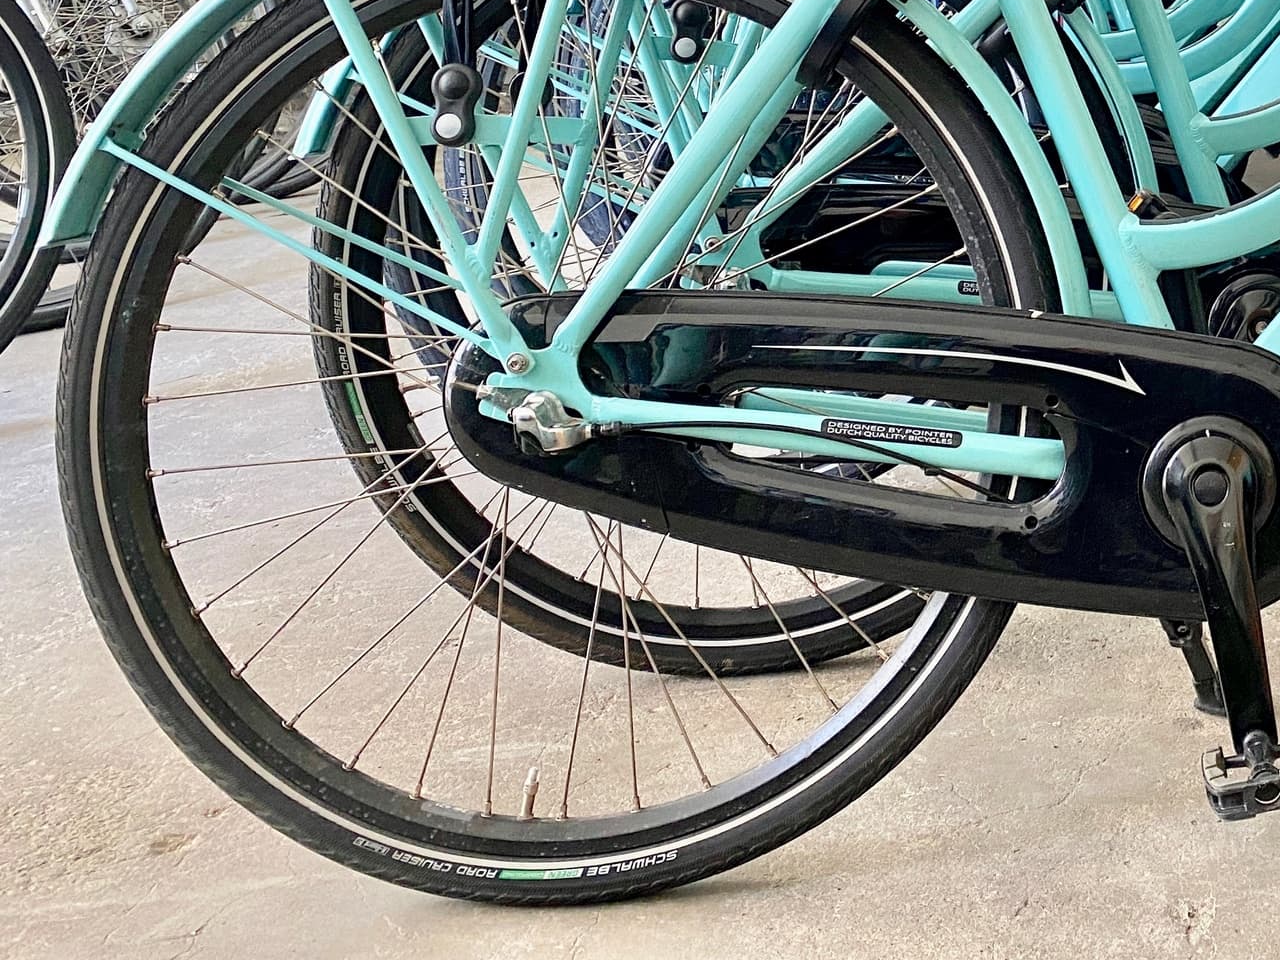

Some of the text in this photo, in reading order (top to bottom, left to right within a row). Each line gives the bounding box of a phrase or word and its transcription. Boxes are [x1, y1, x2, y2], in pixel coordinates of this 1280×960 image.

[333, 291, 344, 338] RUISER
[827, 427, 953, 445] DUTCH QUALITY BICYCLES
[828, 421, 953, 439] DESIGNED BY POINTER
[391, 850, 452, 872] CRUISER
[587, 850, 679, 877] SCHWALBE
[456, 865, 499, 878] ROAD
